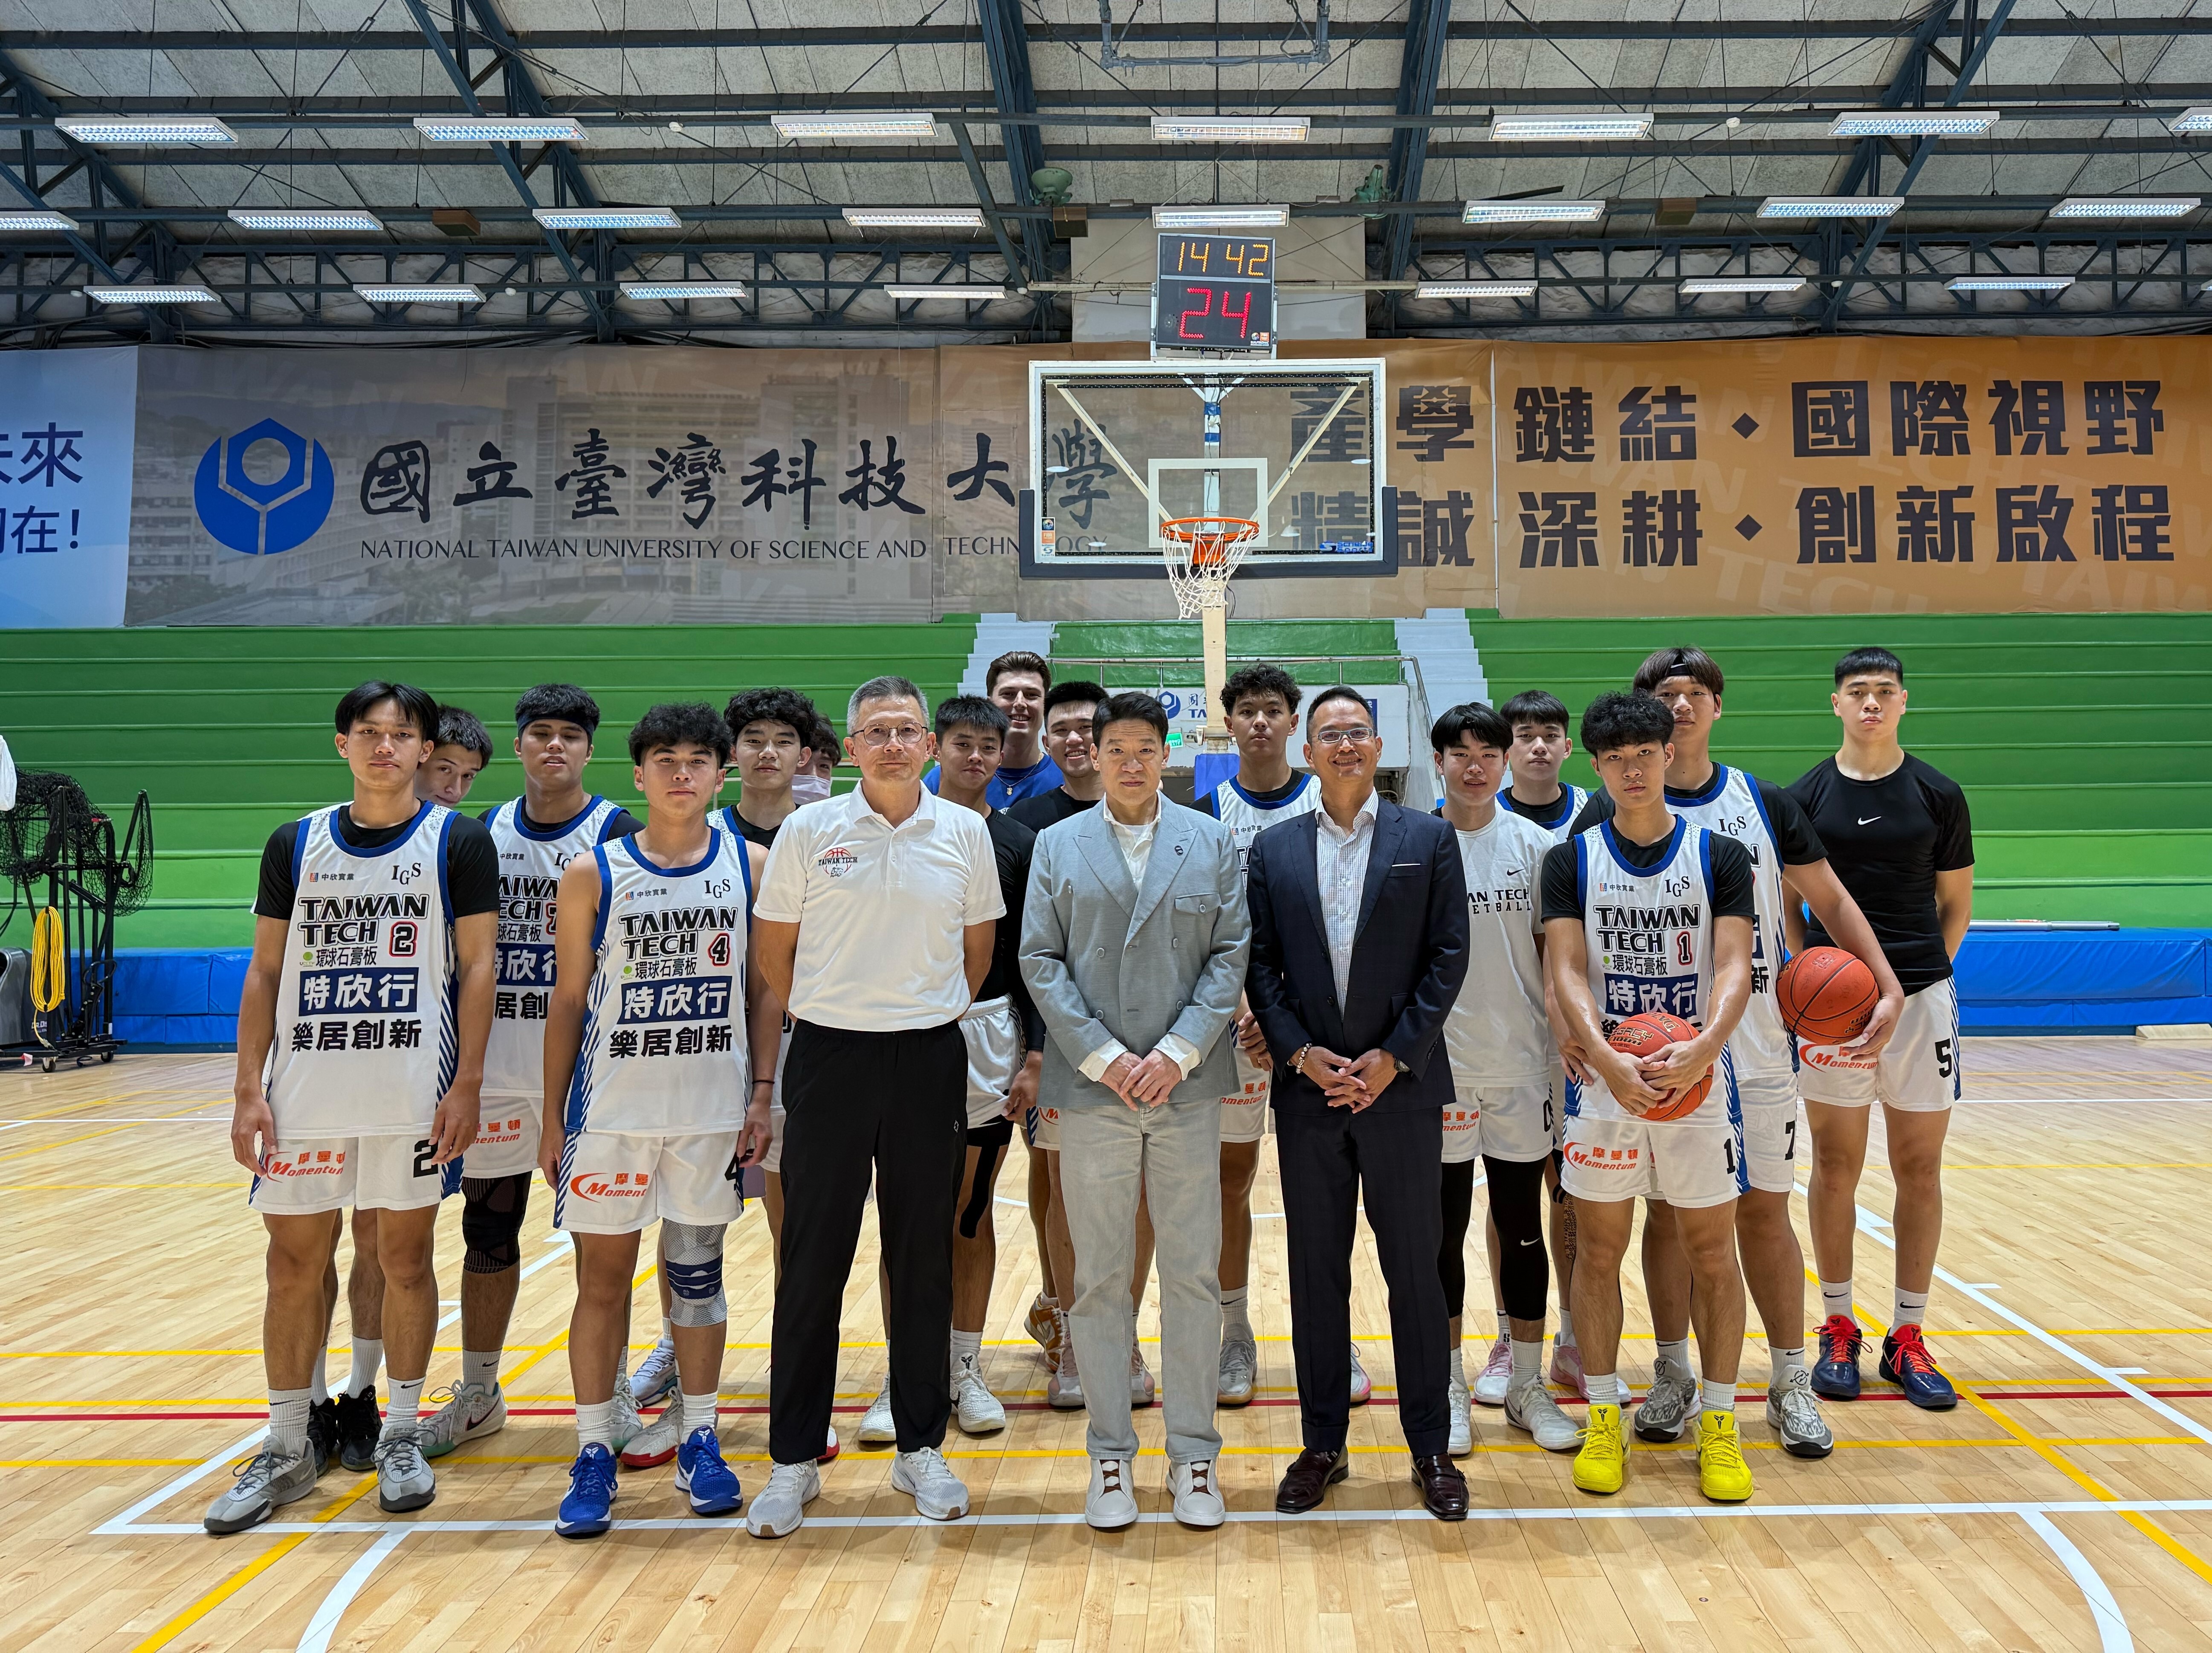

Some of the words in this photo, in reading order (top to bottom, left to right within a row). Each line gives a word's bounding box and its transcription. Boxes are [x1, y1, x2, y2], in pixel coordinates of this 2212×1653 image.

[1178, 241, 1210, 272] 14
[1226, 244, 1269, 276] 42
[1179, 287, 1252, 339] 24
[1791, 380, 2164, 458] 國際視野
[361, 418, 1118, 531] 國立臺灣科技大學
[0, 505, 81, 555] 在!
[1795, 484, 2174, 565] 創新啟程
[361, 539, 480, 560] NATIONAL
[487, 538, 578, 560] TAIWAN
[585, 537, 721, 560] UNIVERSITY
[730, 538, 763, 560] OF
[769, 537, 869, 559] SCIENCE
[877, 538, 926, 558] AND
[944, 535, 1108, 556] TECHNOGY
[1718, 815, 1747, 836] IGS
[391, 862, 421, 885] IGS
[499, 874, 560, 901] AIWA
[1665, 876, 1690, 897] IGS
[704, 879, 731, 899] IGS
[298, 893, 429, 922] TAIWAN
[498, 897, 543, 922] ECH
[618, 906, 738, 938] TAIWAN
[1472, 901, 1531, 914] ETBALL
[1593, 904, 1700, 931] TAIWAN
[298, 919, 379, 948] TECH
[392, 924, 416, 954] 2
[497, 922, 542, 942] 球石膏板
[620, 930, 698, 962] TECH
[1596, 928, 1665, 955] TECH
[316, 946, 378, 968] 環球石膏板
[709, 935, 729, 965] 4
[1678, 933, 1691, 964] 1
[635, 957, 698, 980] 環球石膏板
[1612, 954, 1668, 976] 環球石膏板
[304, 973, 415, 1011] 特欣行
[624, 982, 727, 1020] 特欣行
[1608, 980, 1696, 1016] 特欣行
[292, 1018, 422, 1052] 樂居創新
[609, 1024, 732, 1059] 樂居創新
[1935, 1038, 1952, 1078] 5
[477, 1119, 521, 1133] 曼頓
[1784, 1119, 1795, 1161] 7
[1571, 1151, 1637, 1170] Momentum
[1723, 1138, 1736, 1174] 1
[584, 1182, 647, 1198] Moment
